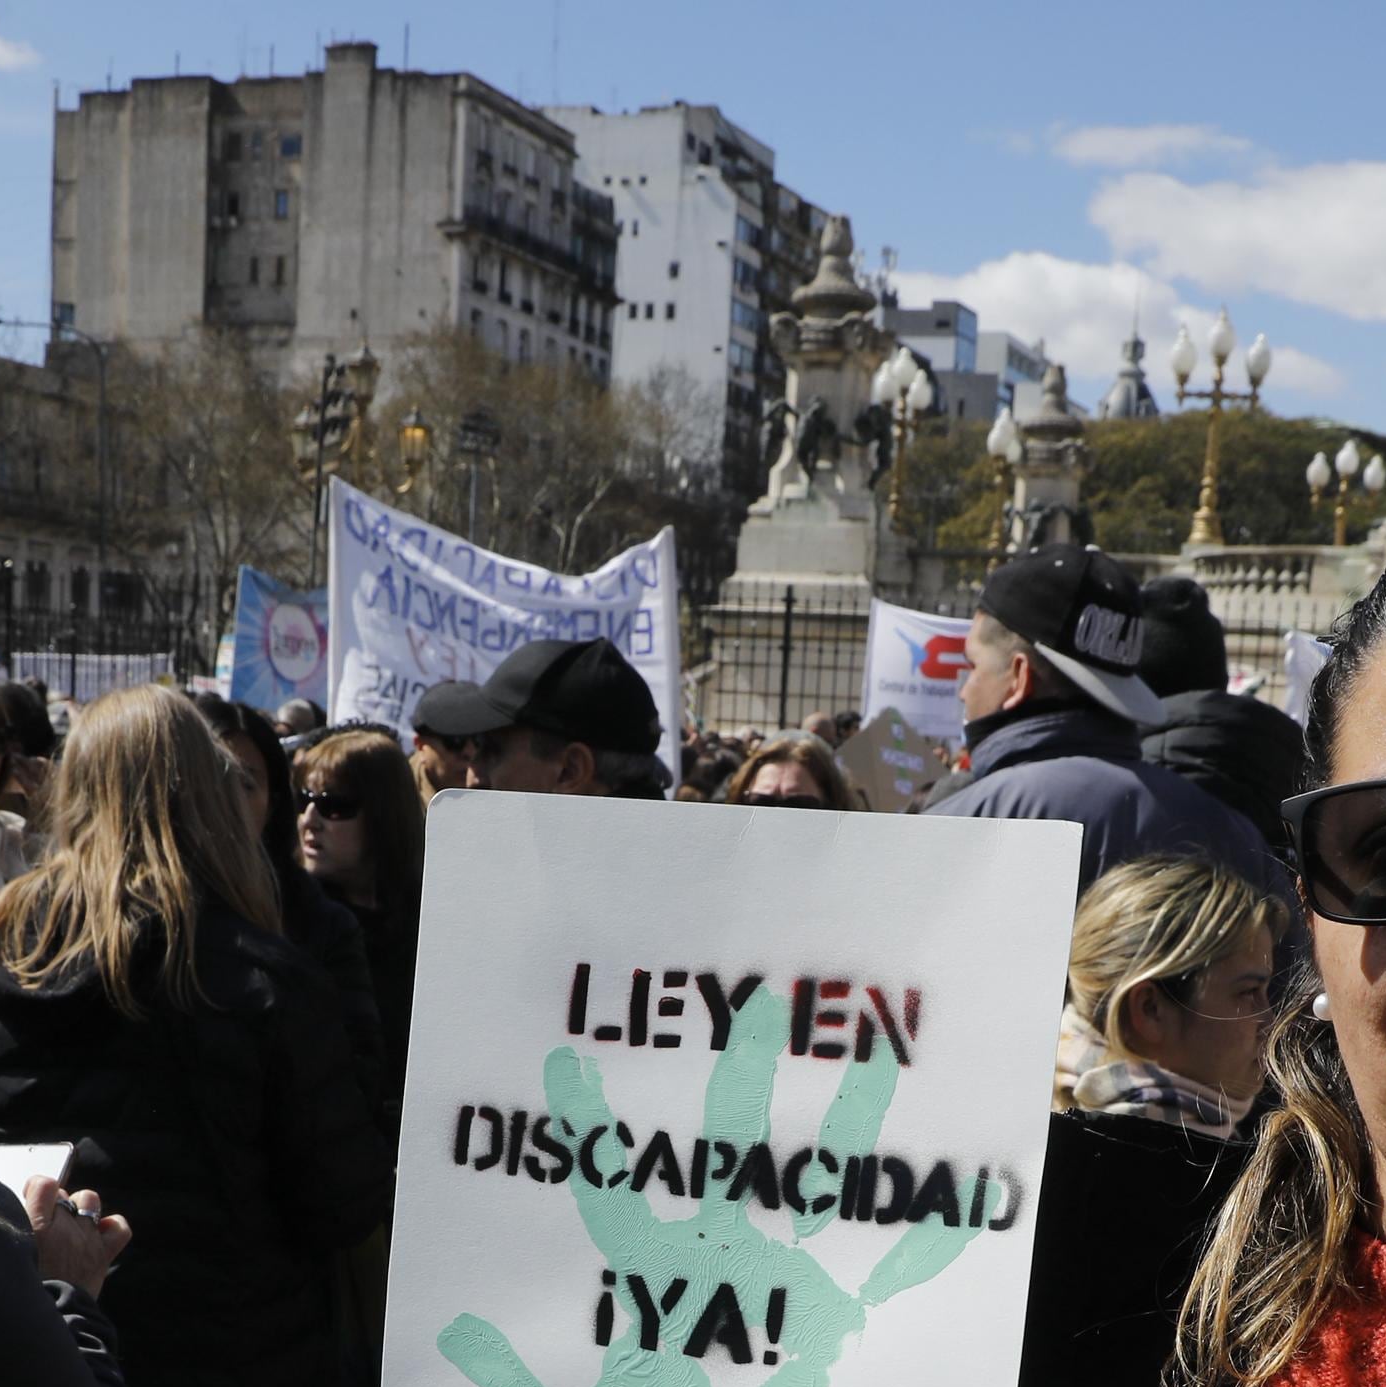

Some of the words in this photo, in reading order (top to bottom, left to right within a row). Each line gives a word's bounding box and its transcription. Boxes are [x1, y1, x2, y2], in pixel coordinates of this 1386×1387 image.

[568, 963, 765, 1051] LEY
[790, 978, 923, 1066] EN
[454, 1105, 1023, 1231] DISCAPACIDAD
[594, 1269, 787, 1365] ¡YA!
